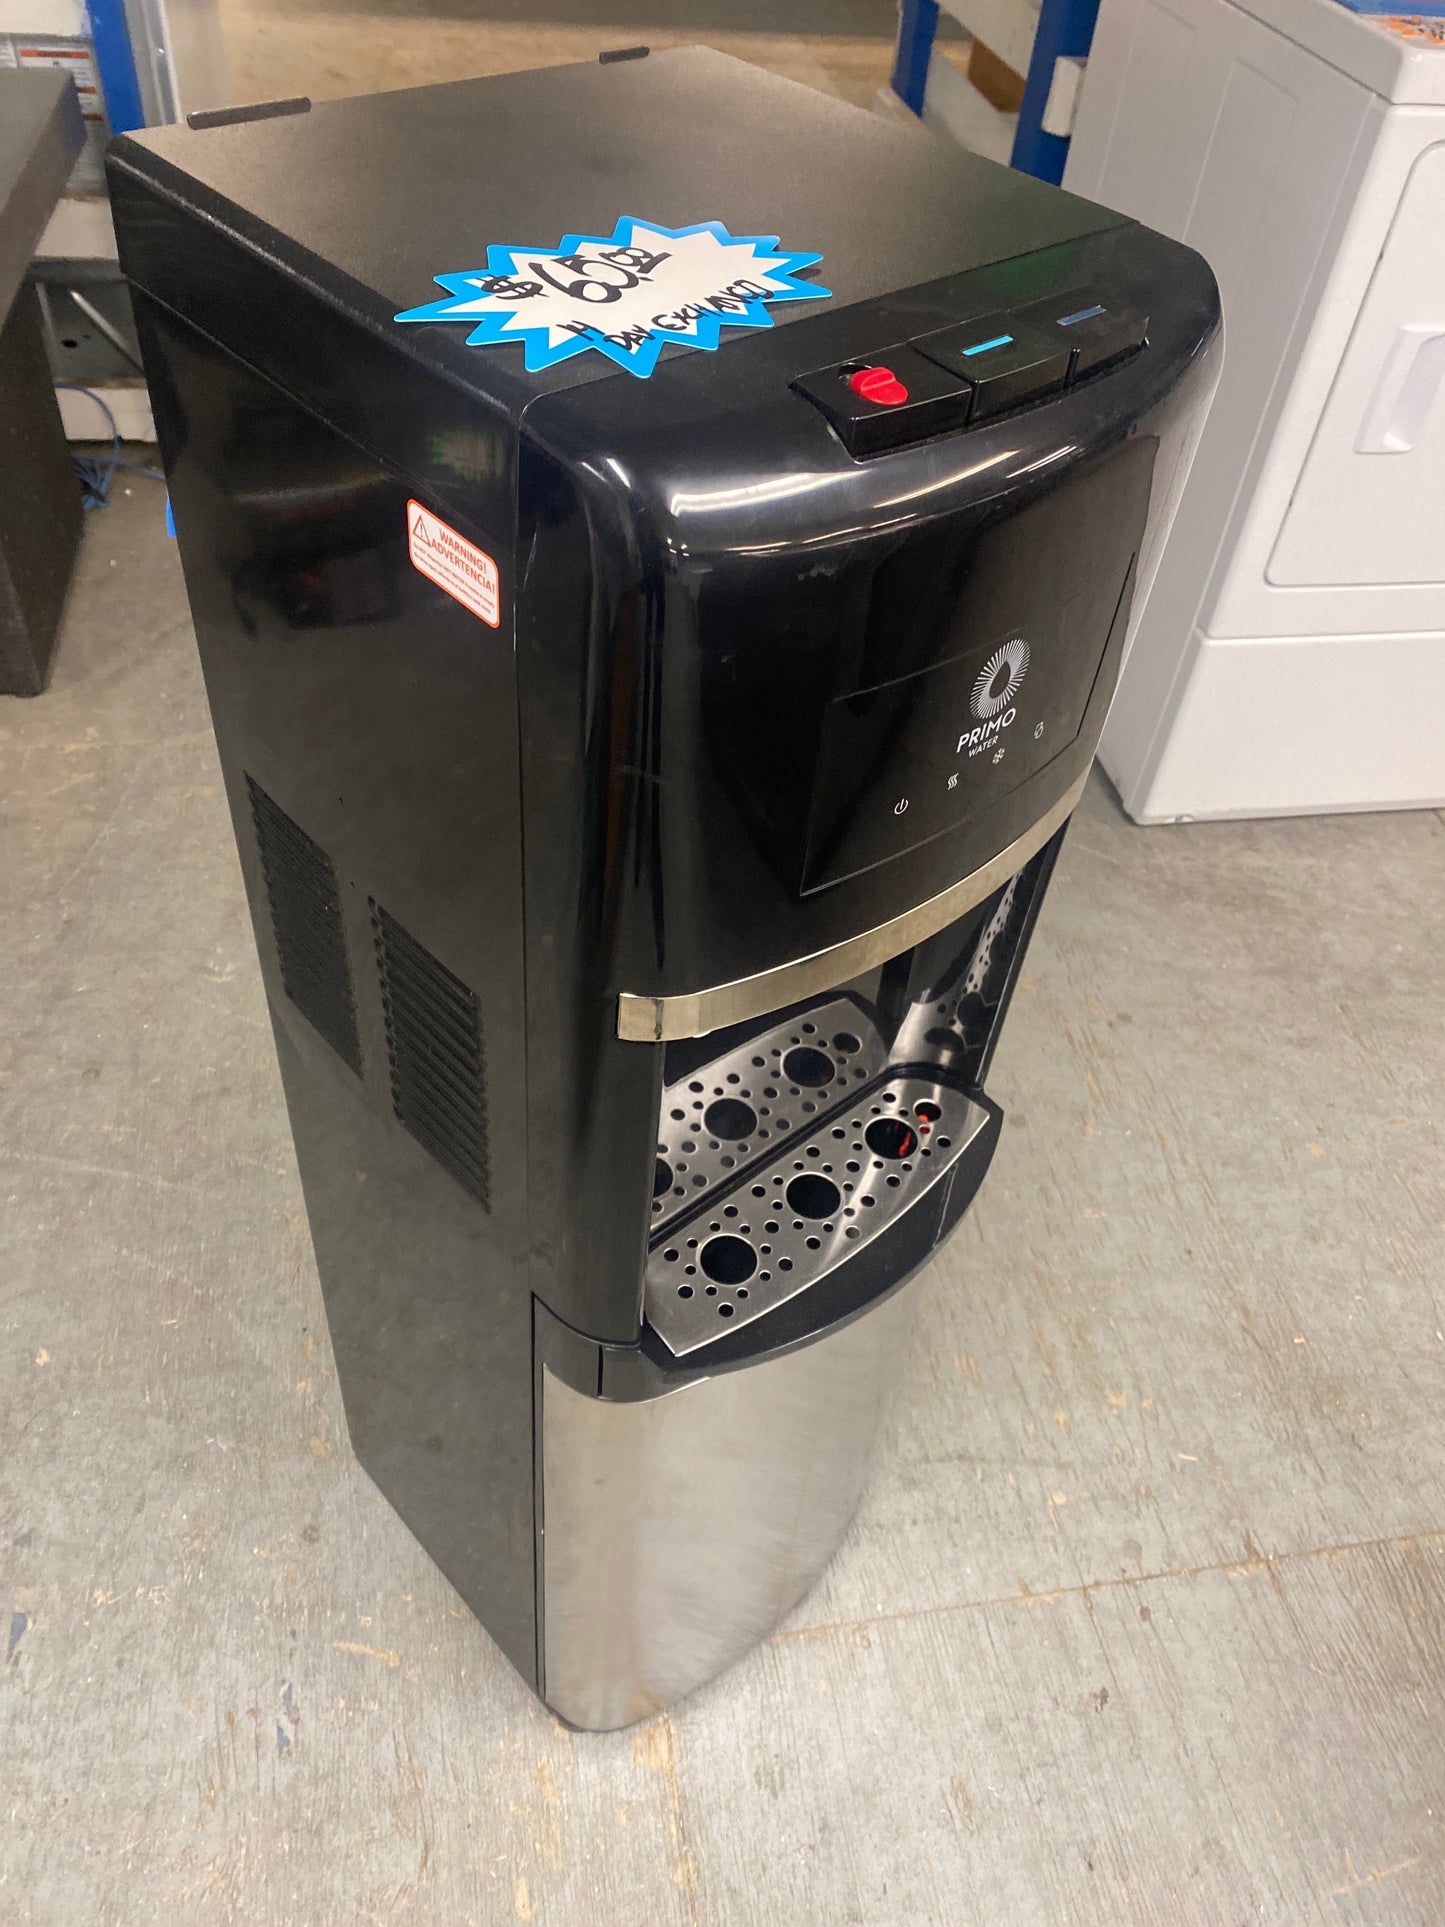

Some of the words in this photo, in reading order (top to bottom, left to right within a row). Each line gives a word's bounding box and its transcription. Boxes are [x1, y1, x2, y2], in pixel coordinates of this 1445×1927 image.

[556, 320, 605, 341] 14
[604, 324, 656, 351] DAY
[430, 539, 495, 595] ADVERTENCIA!
[439, 528, 486, 574] WARNING!
[956, 707, 1016, 753] PRIMO
[968, 735, 999, 758] WATER
